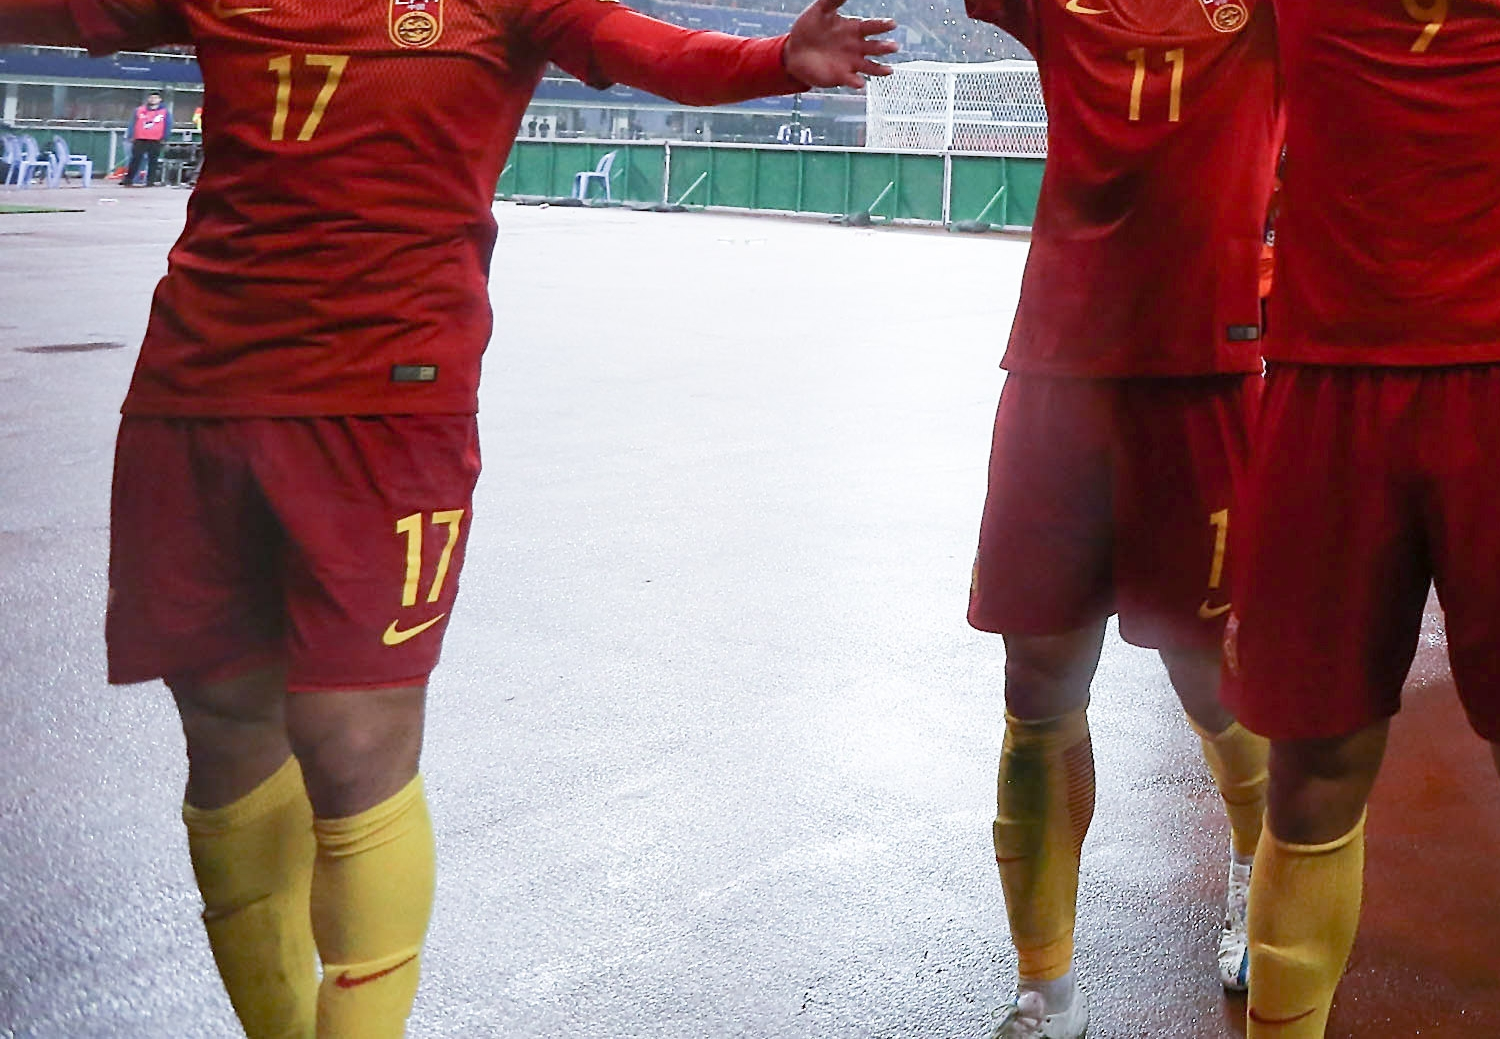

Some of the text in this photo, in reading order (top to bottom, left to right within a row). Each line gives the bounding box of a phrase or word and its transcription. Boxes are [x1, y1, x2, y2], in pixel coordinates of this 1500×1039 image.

[268, 54, 350, 141] 17
[1127, 47, 1184, 122] 11
[397, 510, 465, 607] 17
[1209, 508, 1228, 589] 1
